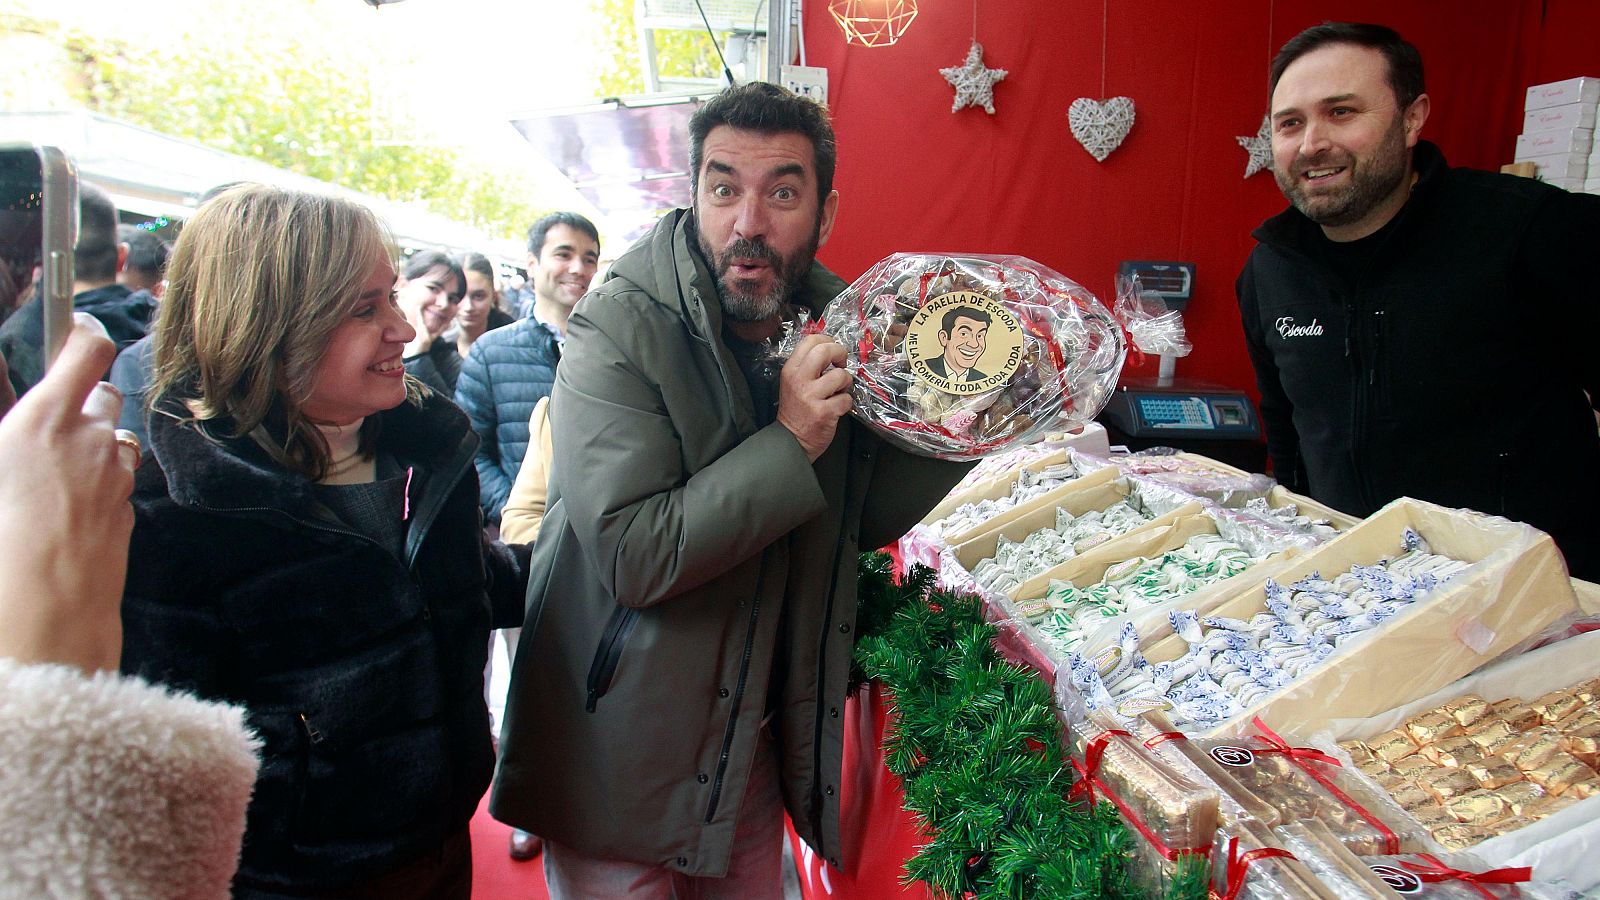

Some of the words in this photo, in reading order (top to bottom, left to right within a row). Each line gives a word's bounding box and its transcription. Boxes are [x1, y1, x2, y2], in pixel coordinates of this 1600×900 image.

[915, 311, 929, 326] LA
[928, 294, 966, 314] PAELLA
[970, 295, 985, 307] DE
[985, 303, 1017, 332] ESCODA
[1276, 316, 1323, 339] Escoda
[908, 333, 918, 346] ME
[909, 346, 919, 359] LA
[1004, 345, 1020, 371] TODA
[914, 360, 950, 390] COMERÍA
[983, 370, 1008, 388] TODA
[954, 382, 982, 392] TODA
